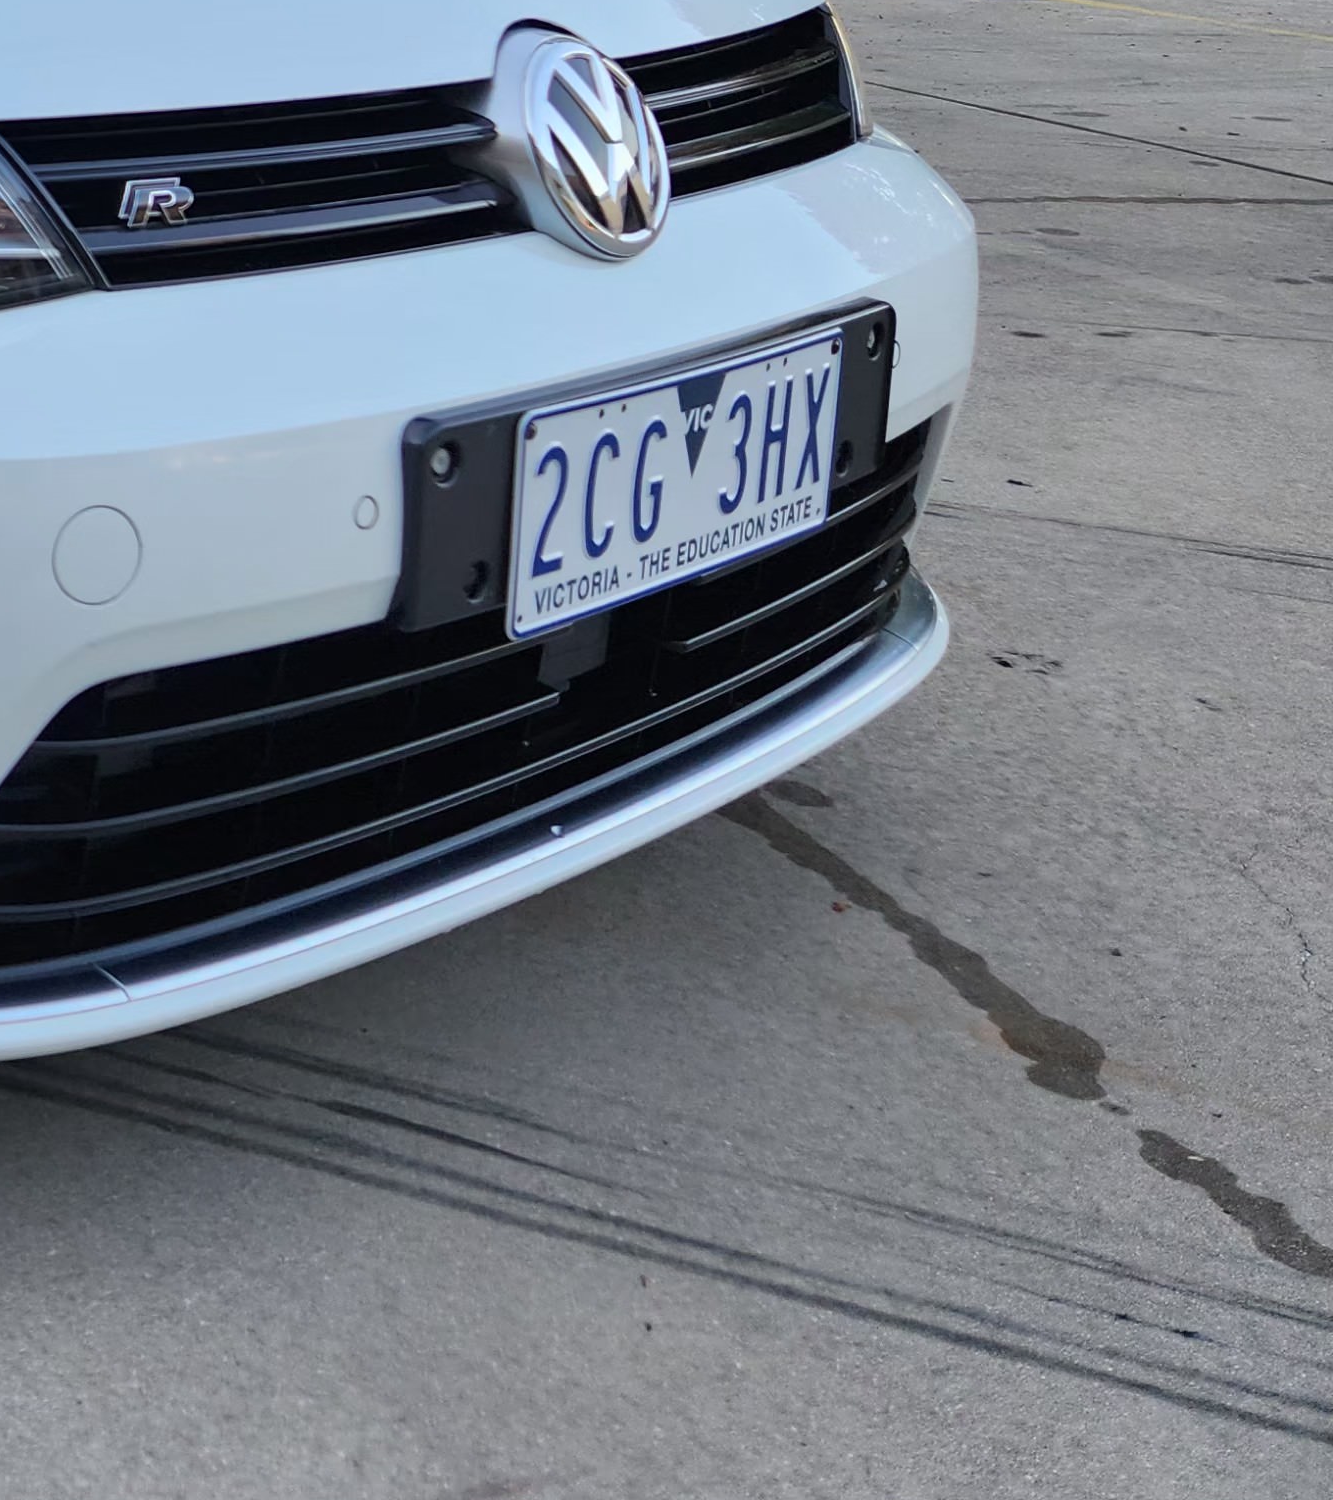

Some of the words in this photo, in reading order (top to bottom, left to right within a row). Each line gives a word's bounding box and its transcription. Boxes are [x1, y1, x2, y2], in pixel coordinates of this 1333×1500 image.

[126, 185, 195, 229] R
[684, 403, 714, 438] VIC
[531, 416, 668, 578] 2CG
[717, 363, 831, 516] 3HX
[534, 565, 621, 615] VICTORIA
[639, 546, 672, 581] THE
[676, 513, 766, 567] EDUCATION
[770, 495, 813, 532] STATE
